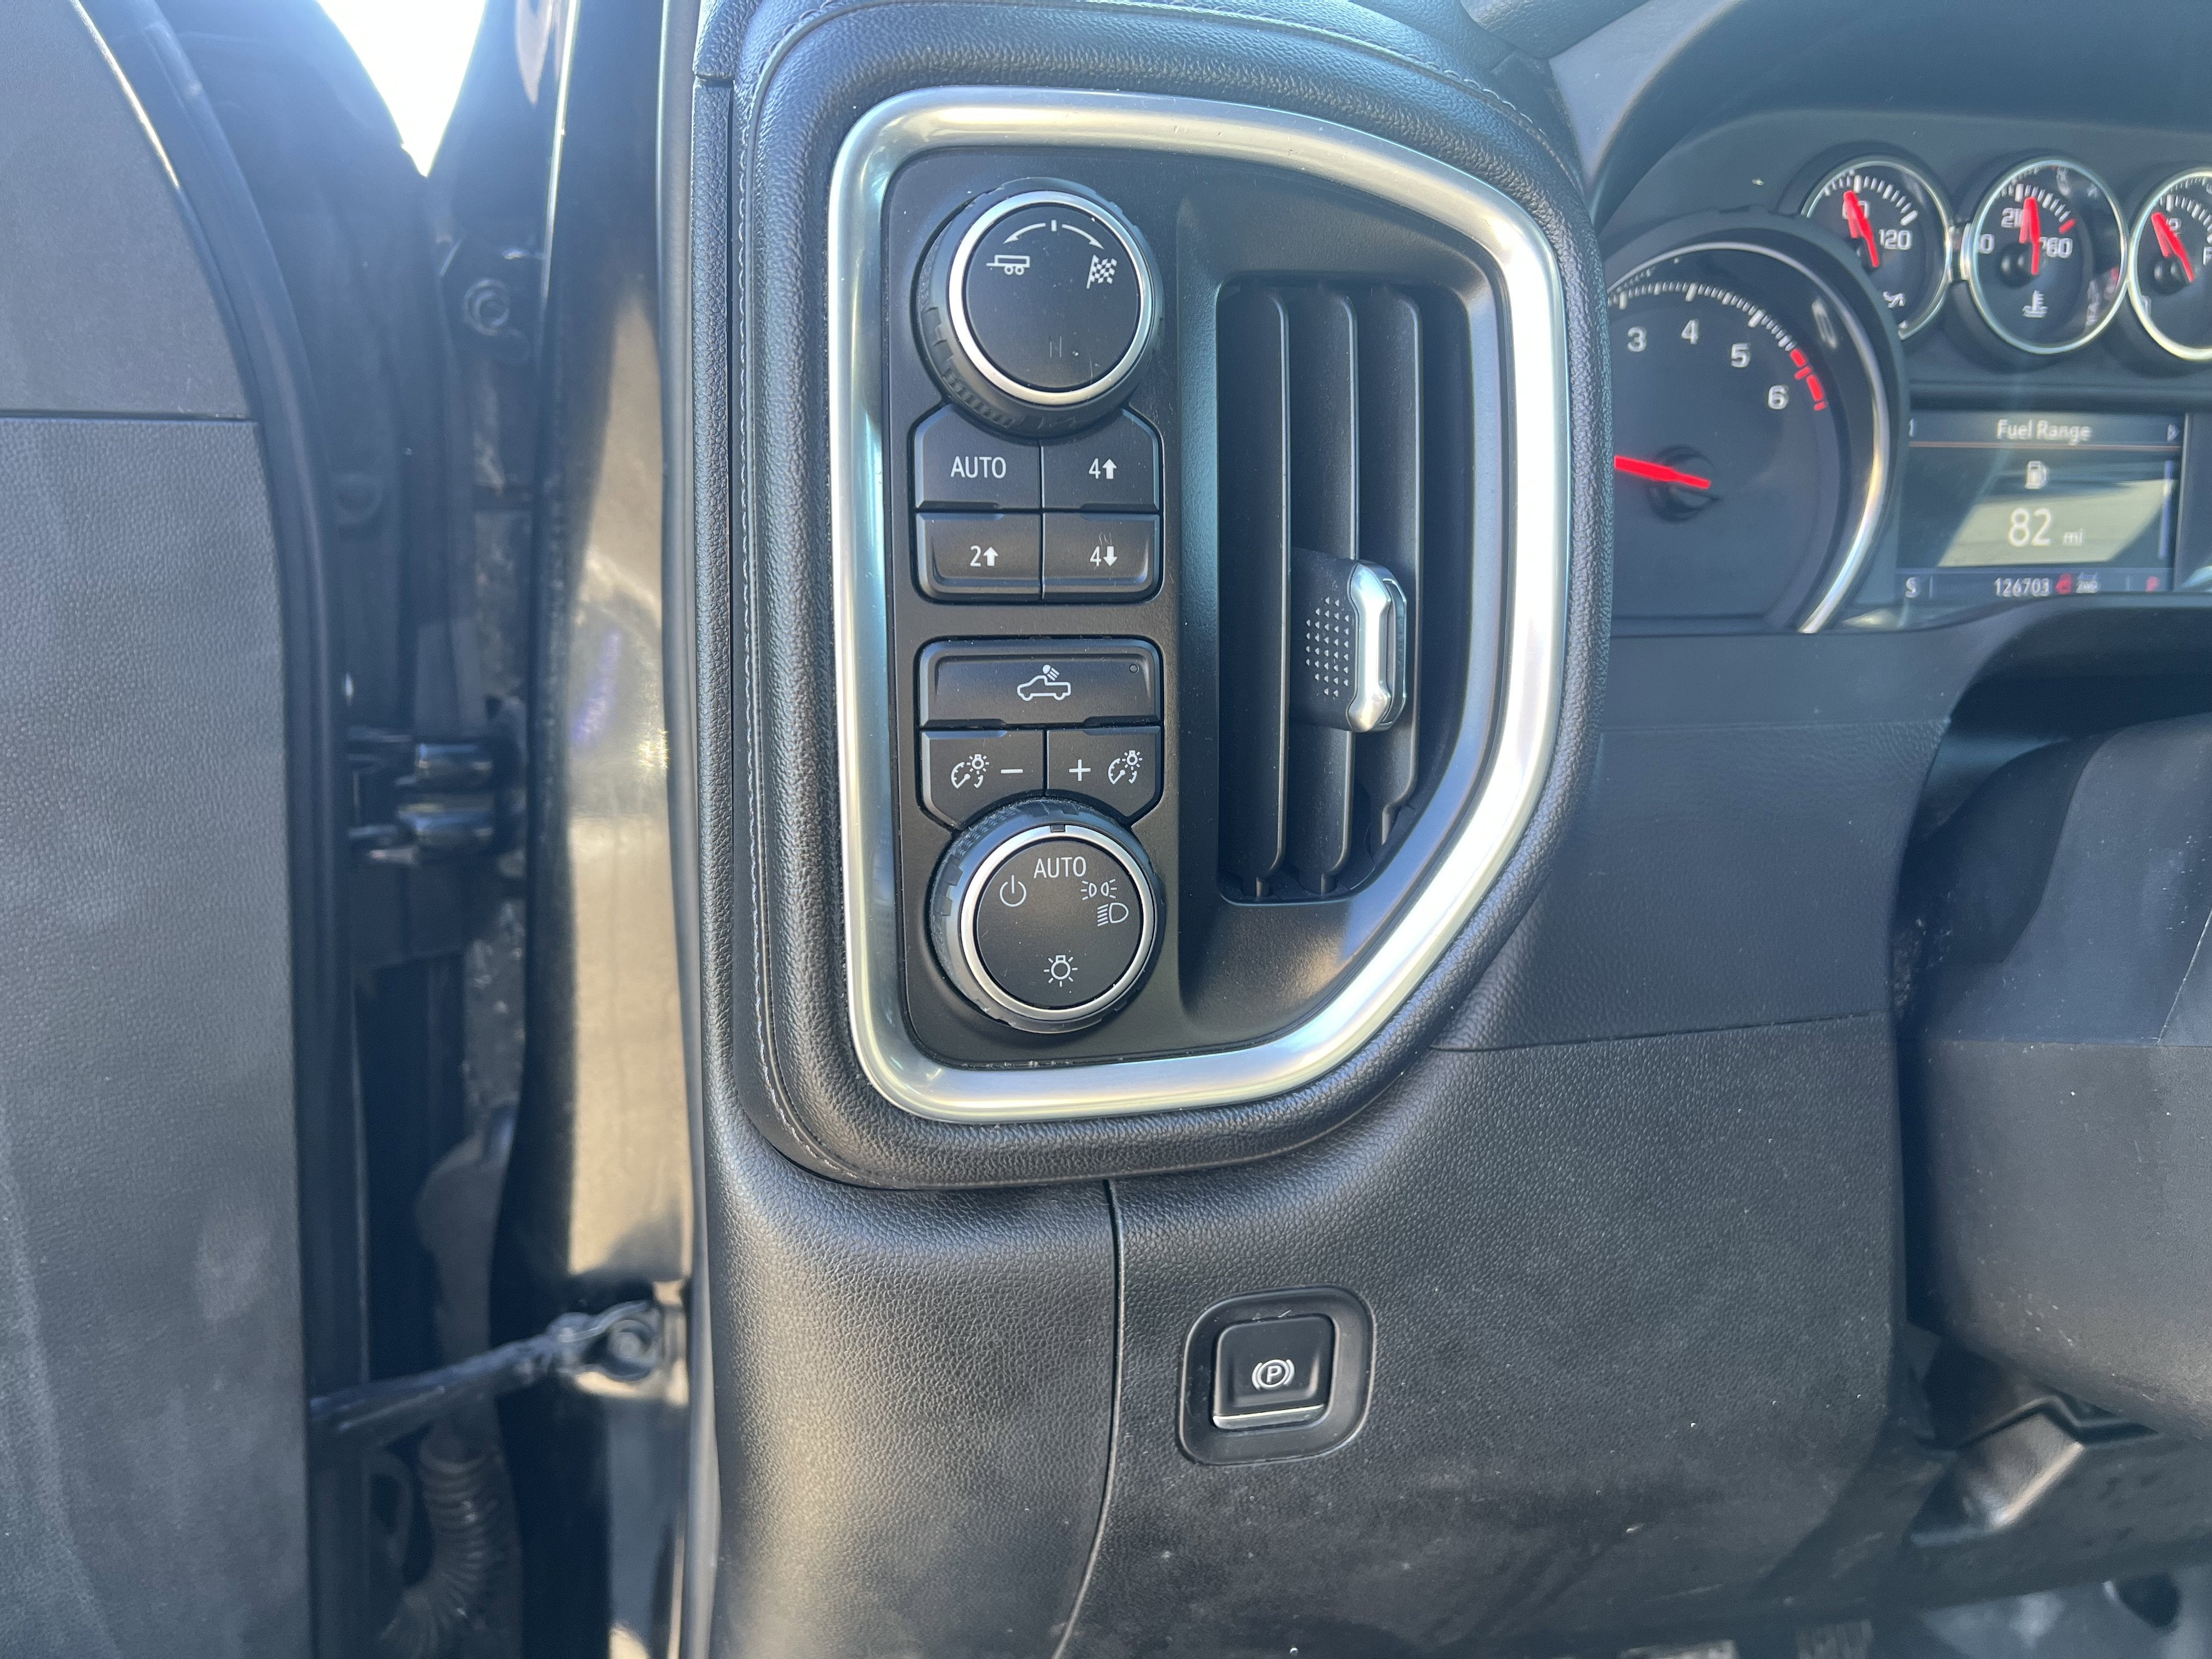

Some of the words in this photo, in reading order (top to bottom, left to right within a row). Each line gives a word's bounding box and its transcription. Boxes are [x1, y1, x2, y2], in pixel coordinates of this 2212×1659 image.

[1878, 229, 1912, 250] 120
[1627, 327, 1646, 352] 3
[1680, 319, 1700, 345] 4
[1730, 342, 1751, 368] 5
[1768, 385, 1788, 410] 6
[1996, 419, 2033, 439] Fuel
[2036, 420, 2092, 445] Range
[950, 456, 1007, 479] AUTO
[2007, 507, 2052, 547] 82
[1033, 856, 1086, 879] AUTO
[1266, 1365, 1283, 1383] P
